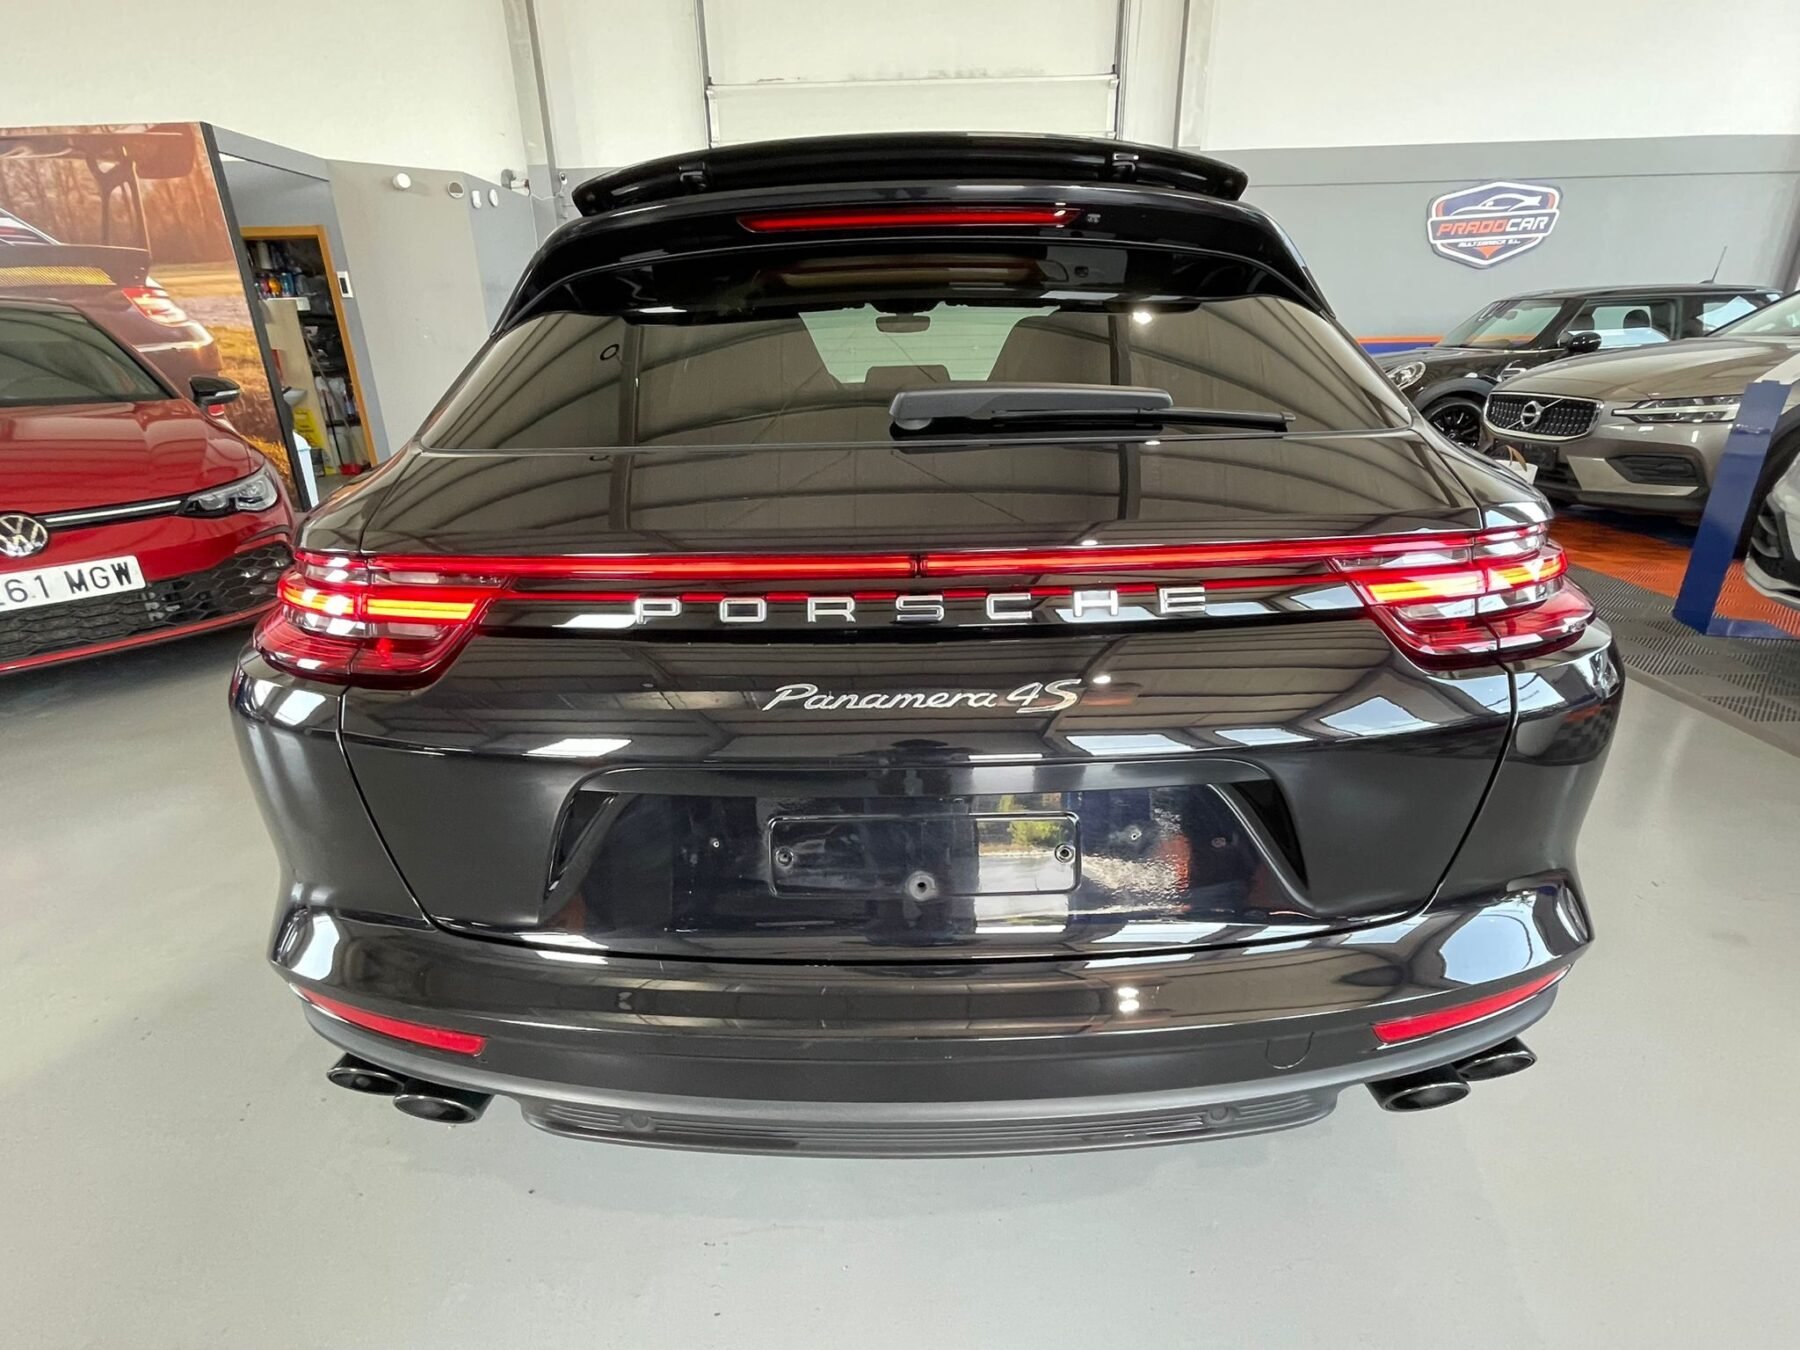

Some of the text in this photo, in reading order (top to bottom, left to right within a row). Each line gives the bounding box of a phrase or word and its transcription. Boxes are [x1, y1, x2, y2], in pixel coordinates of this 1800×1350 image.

[1437, 217, 1549, 236] PRADOCAR
[0, 562, 132, 605] 61 MGW
[635, 586, 1206, 623] PORSCHE
[762, 679, 1081, 713] Panamera 4S
